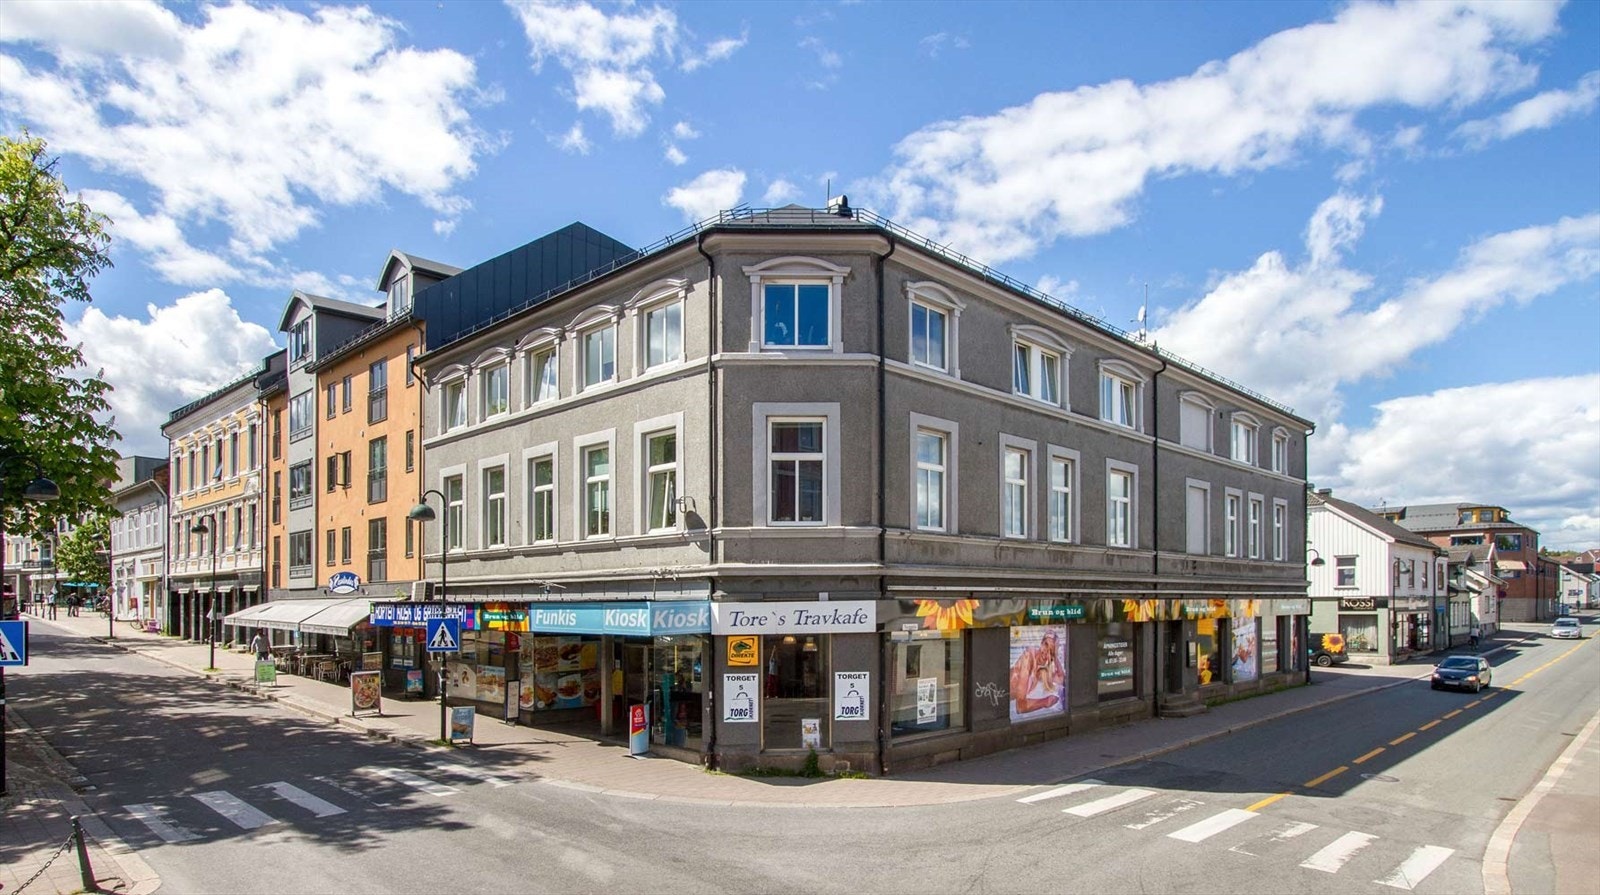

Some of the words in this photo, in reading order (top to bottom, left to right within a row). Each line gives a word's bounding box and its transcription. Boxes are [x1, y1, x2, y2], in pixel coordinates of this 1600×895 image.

[535, 609, 576, 626] Funkis
[605, 610, 647, 628] Kiosk
[653, 609, 708, 629] Kiosk
[793, 608, 868, 626] Travkafe
[730, 708, 748, 717] TORG
[841, 706, 859, 715] TORG
